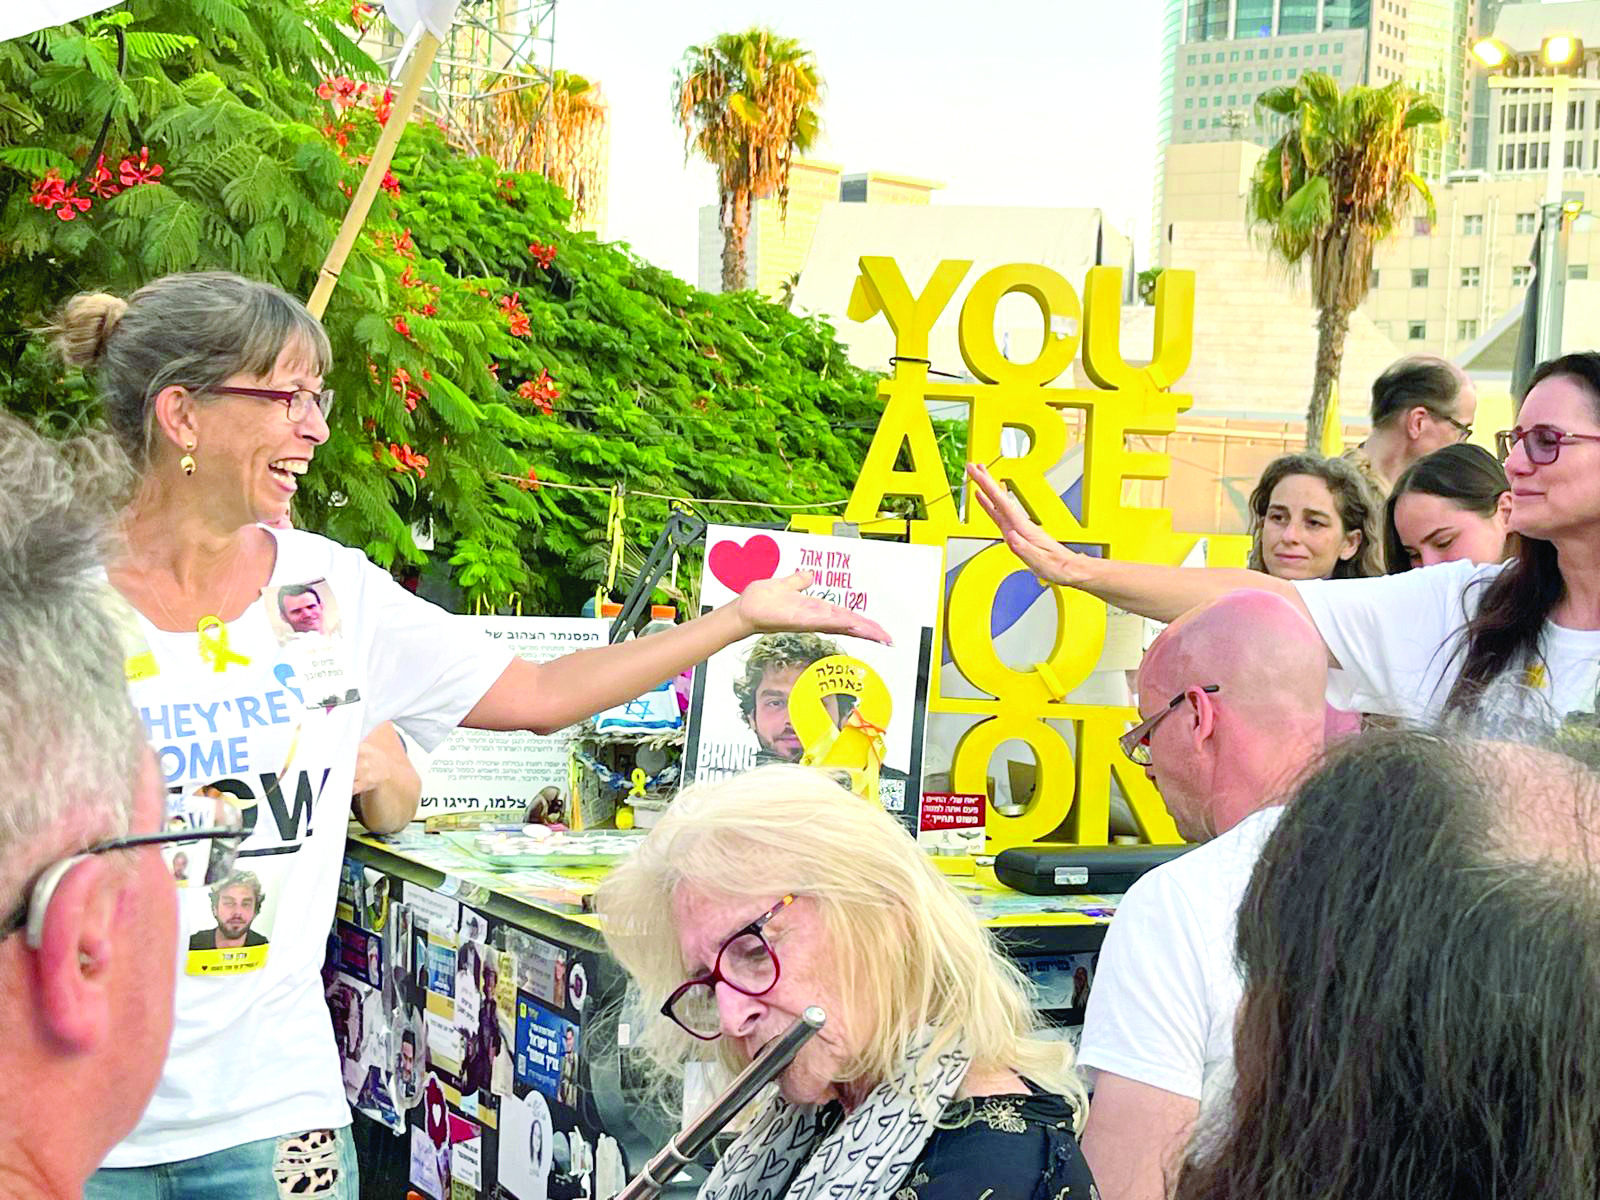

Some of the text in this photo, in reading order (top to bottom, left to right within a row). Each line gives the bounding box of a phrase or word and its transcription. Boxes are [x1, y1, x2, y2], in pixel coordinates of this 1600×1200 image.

[858, 256, 1195, 391] YOU
[844, 390, 1176, 529] ARE
[800, 548, 851, 569] אלון אהל
[826, 571, 852, 589] OHEL
[485, 629, 599, 641] הפסנתר הצהוב של
[141, 688, 291, 741] HEY'RE
[158, 735, 250, 783] OME
[699, 741, 758, 770] BRING
[420, 795, 526, 812] צלמו, תייגו וש
